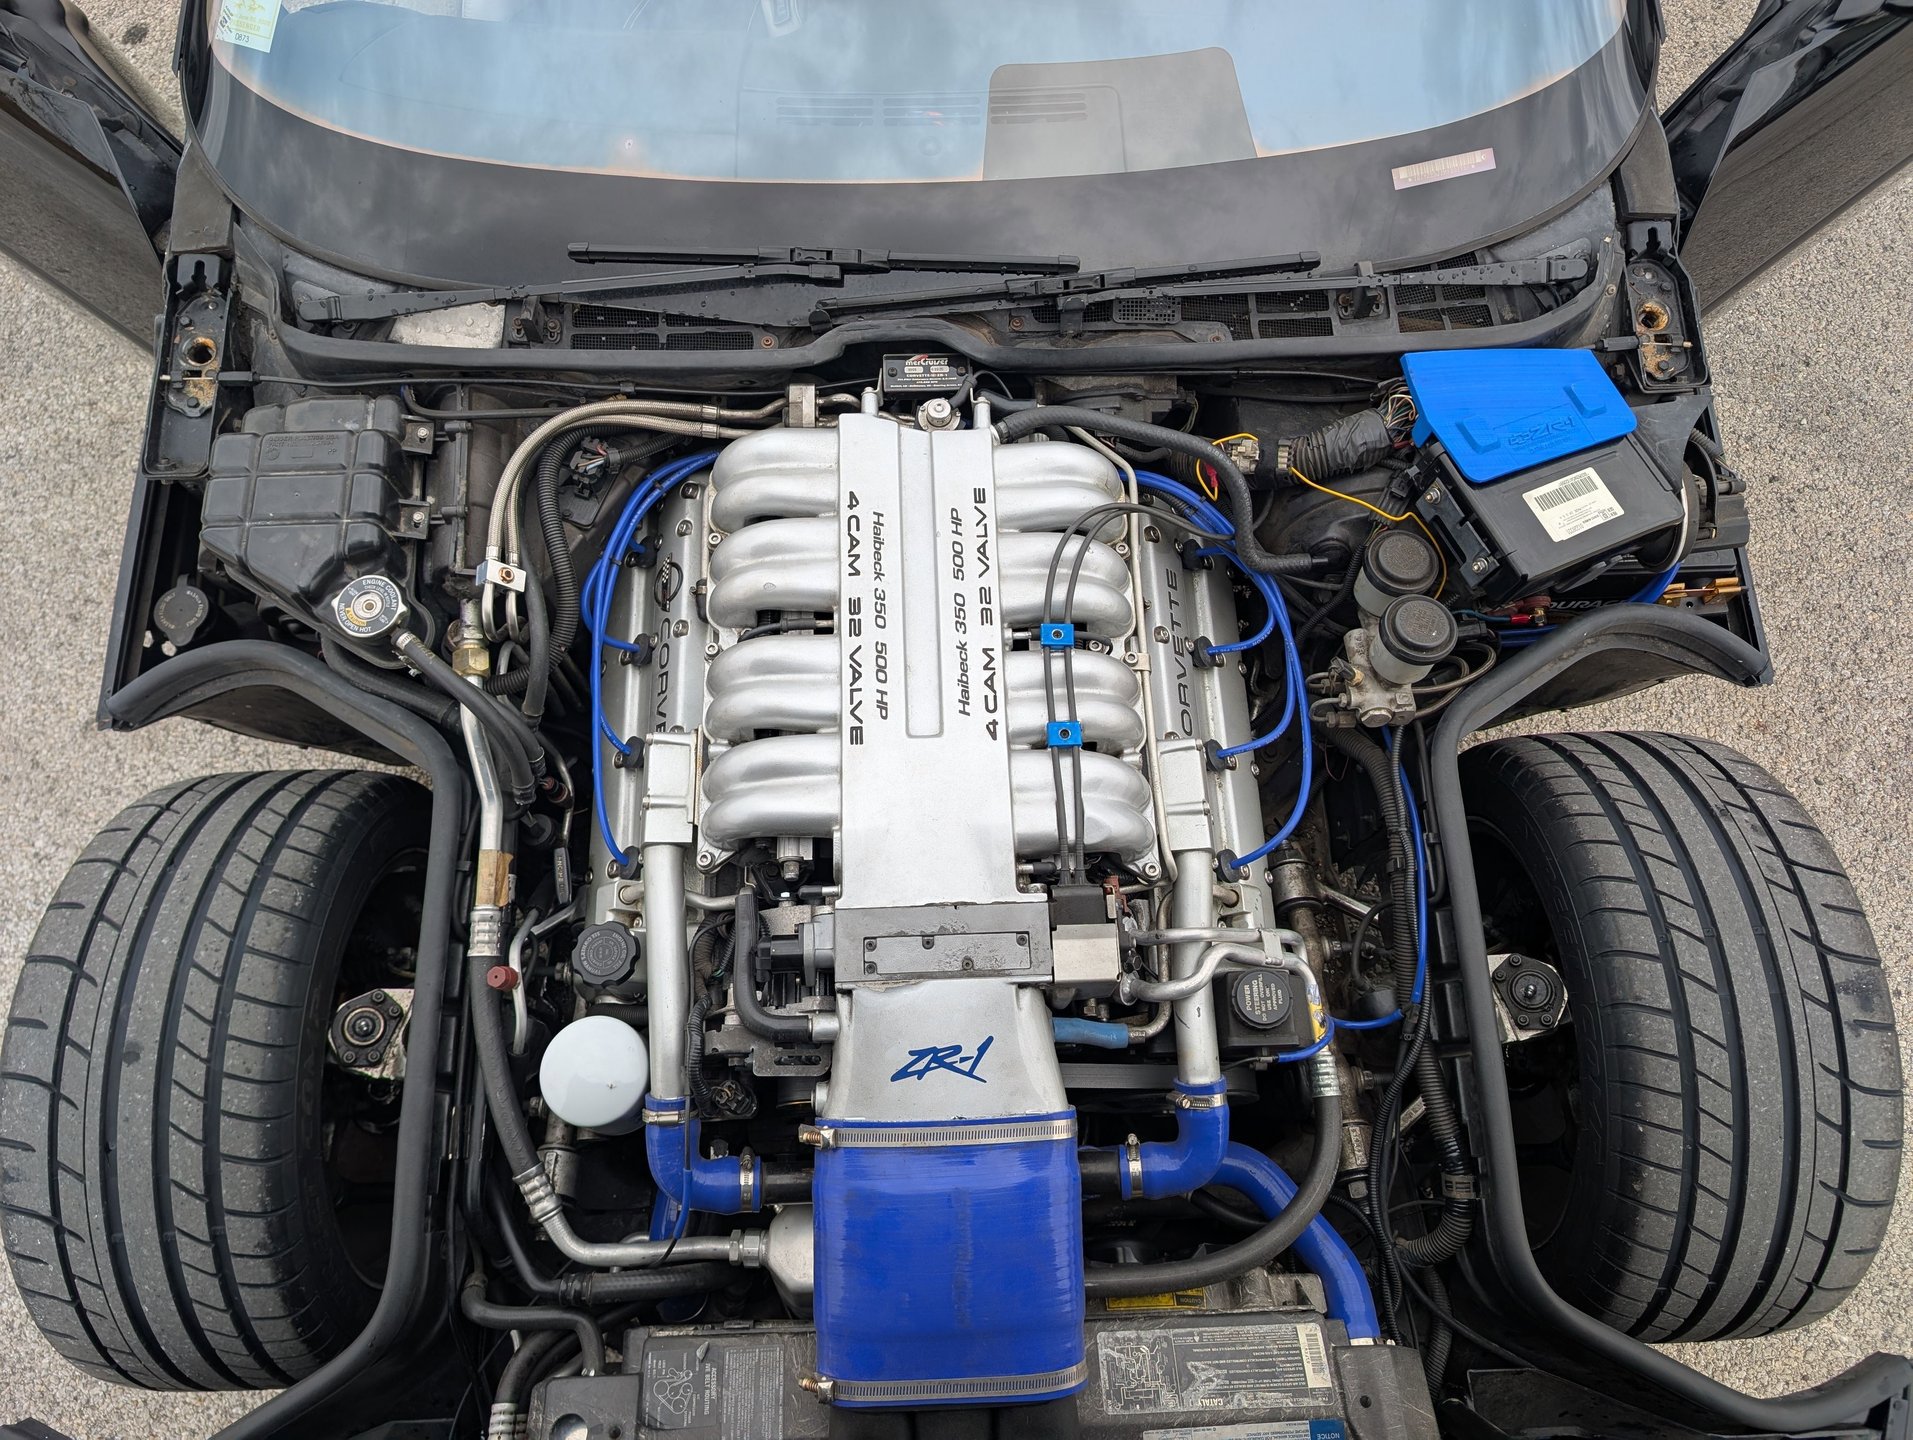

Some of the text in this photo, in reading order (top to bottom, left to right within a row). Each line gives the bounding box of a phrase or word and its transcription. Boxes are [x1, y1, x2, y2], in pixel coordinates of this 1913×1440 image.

[338, 602, 348, 622] NEVER
[344, 620, 358, 632] OPEN
[362, 580, 398, 611] ENGINE COOLANT
[847, 491, 864, 745] 4 CAM 32 VALVE
[873, 512, 888, 720] Haibeck 350 500 HP
[951, 508, 970, 716] Haibeck 350 500 HP
[973, 488, 998, 741] 4 CAM 32 VALVE
[656, 618, 670, 732] CORVE
[1166, 568, 1192, 736] ORVETTE
[1244, 985, 1252, 1010] POWER
[1252, 980, 1261, 1015] STEERING
[1262, 1013, 1267, 1021] DO
[890, 1036, 994, 1083] ZR-1
